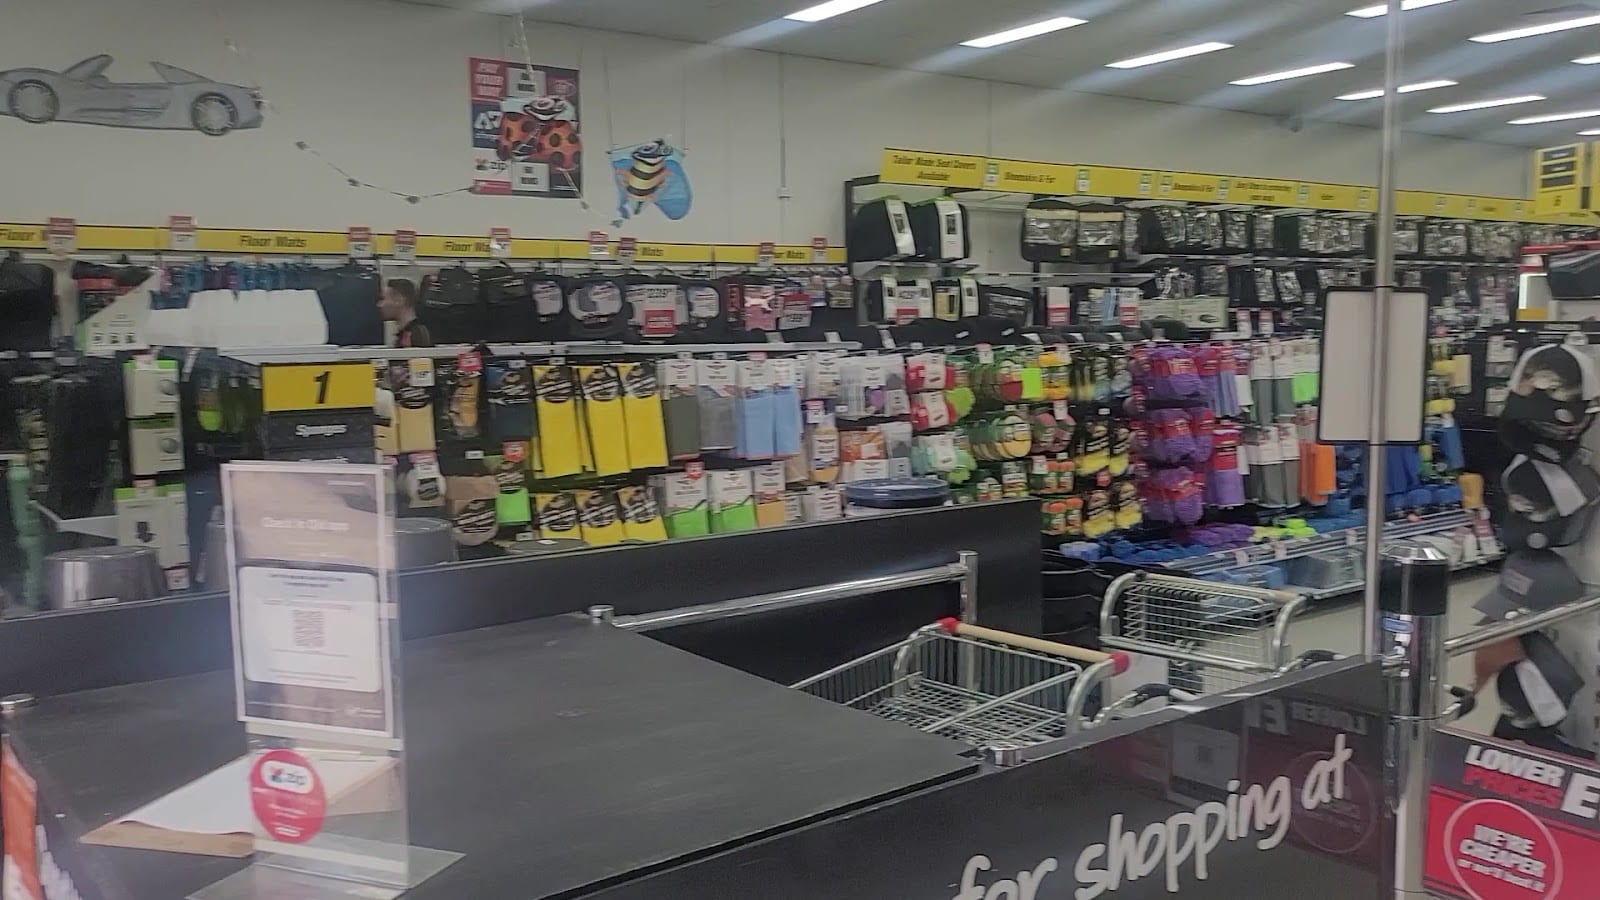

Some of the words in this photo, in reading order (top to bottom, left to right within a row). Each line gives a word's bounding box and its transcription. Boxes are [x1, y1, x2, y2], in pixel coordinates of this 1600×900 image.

[239, 235, 272, 249] Floor
[276, 236, 307, 249] Mats
[445, 241, 471, 252] Floor
[314, 371, 331, 404] 1
[295, 424, 348, 438] Sponges
[1464, 744, 1566, 788] LOWER
[1462, 765, 1564, 809] PRICES
[953, 855, 1058, 900] for
[1073, 775, 1292, 900] shopping
[1301, 733, 1354, 810] at
[1474, 824, 1536, 856] WE'RE
[1459, 839, 1547, 878] CHEAPER
